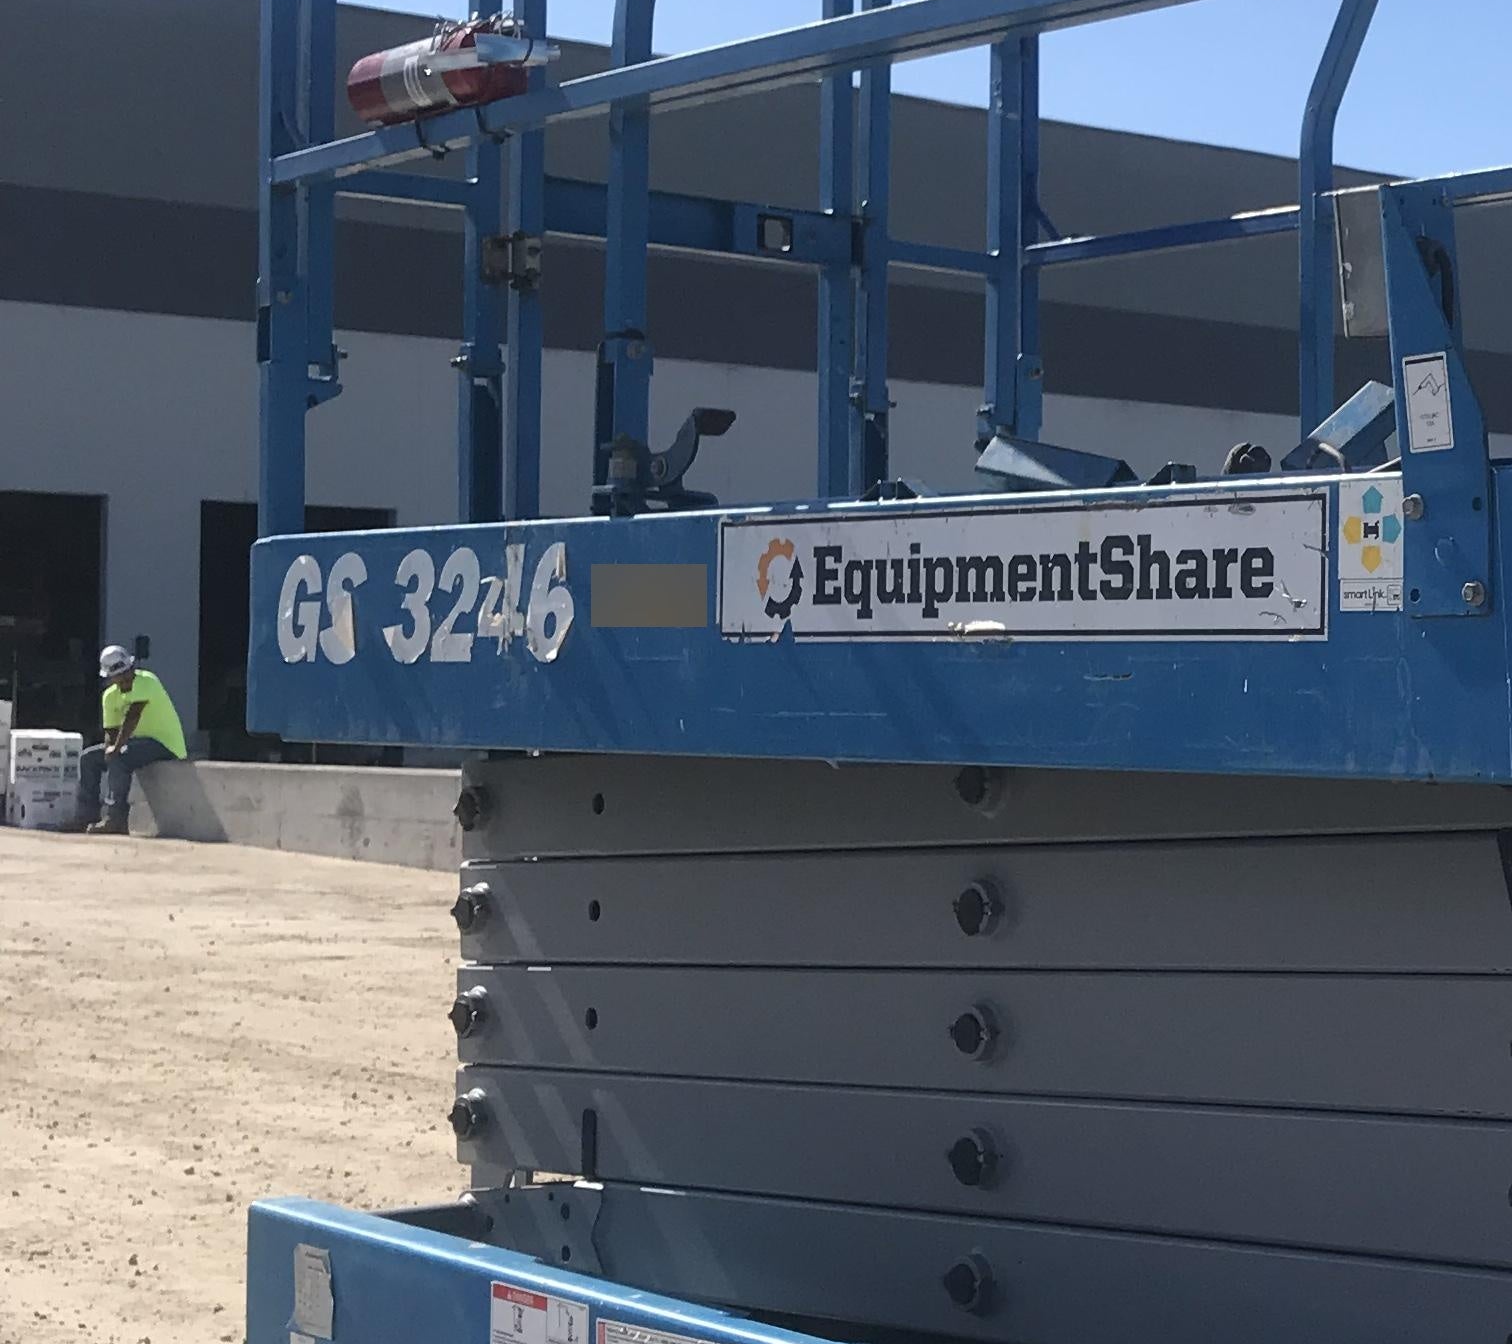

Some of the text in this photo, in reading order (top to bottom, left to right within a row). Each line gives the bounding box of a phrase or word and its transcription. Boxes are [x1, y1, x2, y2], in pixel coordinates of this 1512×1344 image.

[278, 541, 574, 664] GS 3246
[812, 533, 1274, 619] EquipmentShare
